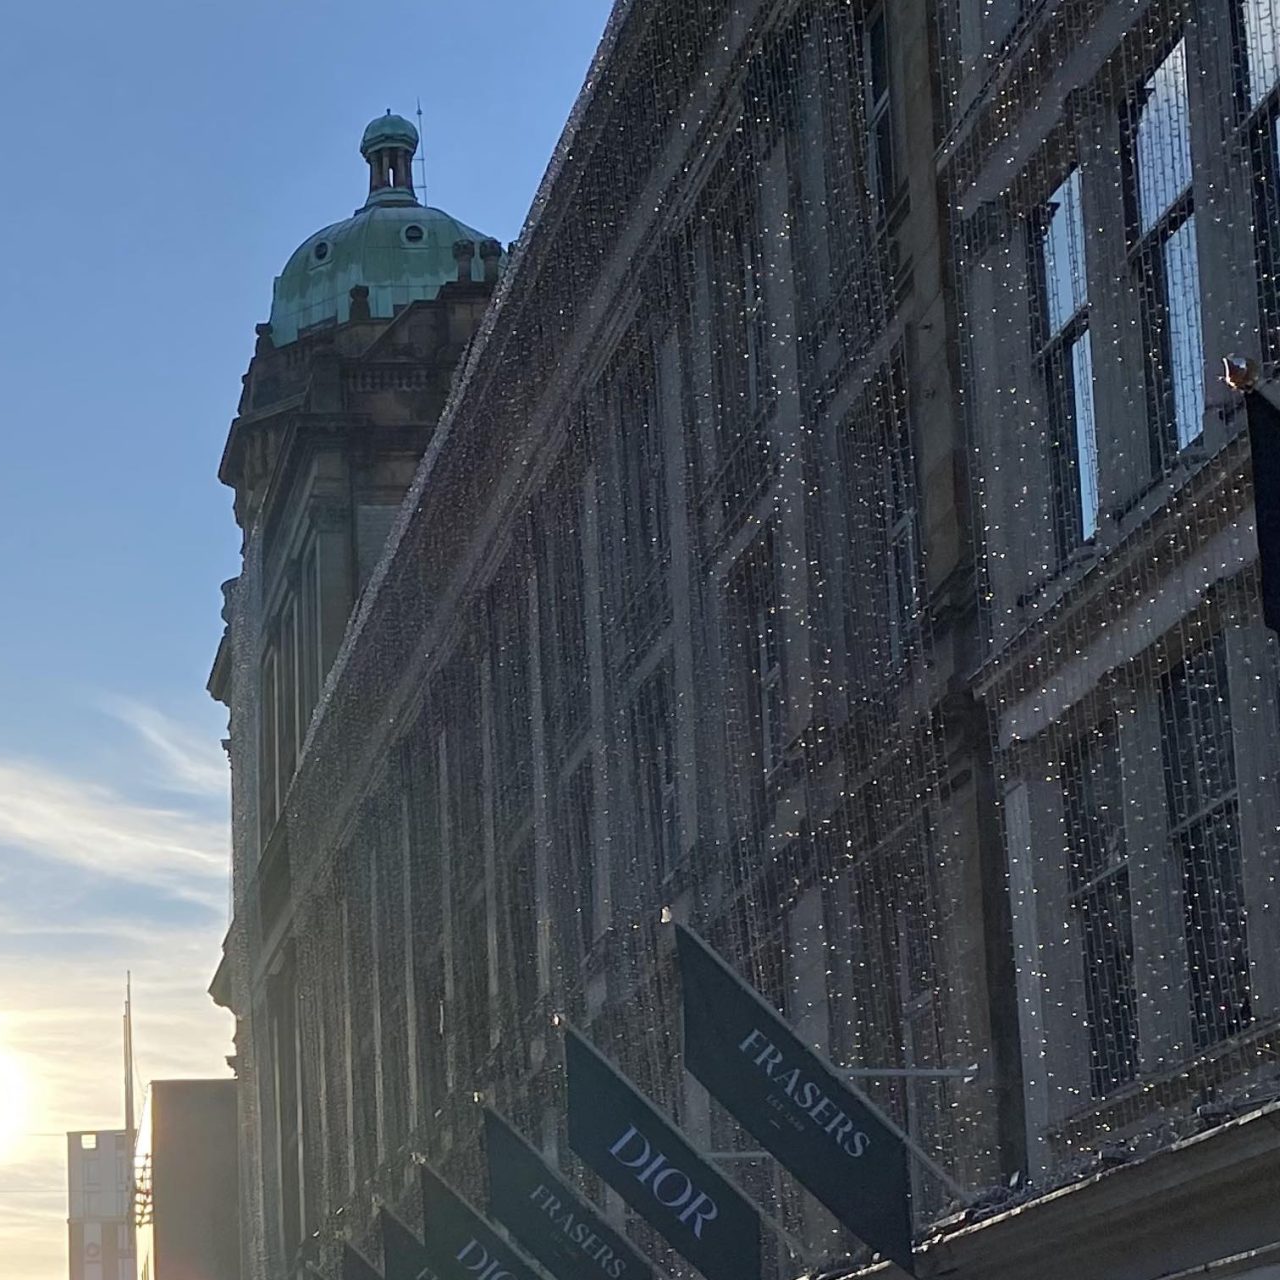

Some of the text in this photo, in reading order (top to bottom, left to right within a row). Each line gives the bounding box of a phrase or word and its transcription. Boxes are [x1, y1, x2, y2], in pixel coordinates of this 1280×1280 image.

[738, 1028, 871, 1158] FRASERS
[528, 1184, 627, 1279] FRASERS
[608, 1123, 718, 1240] DIOR
